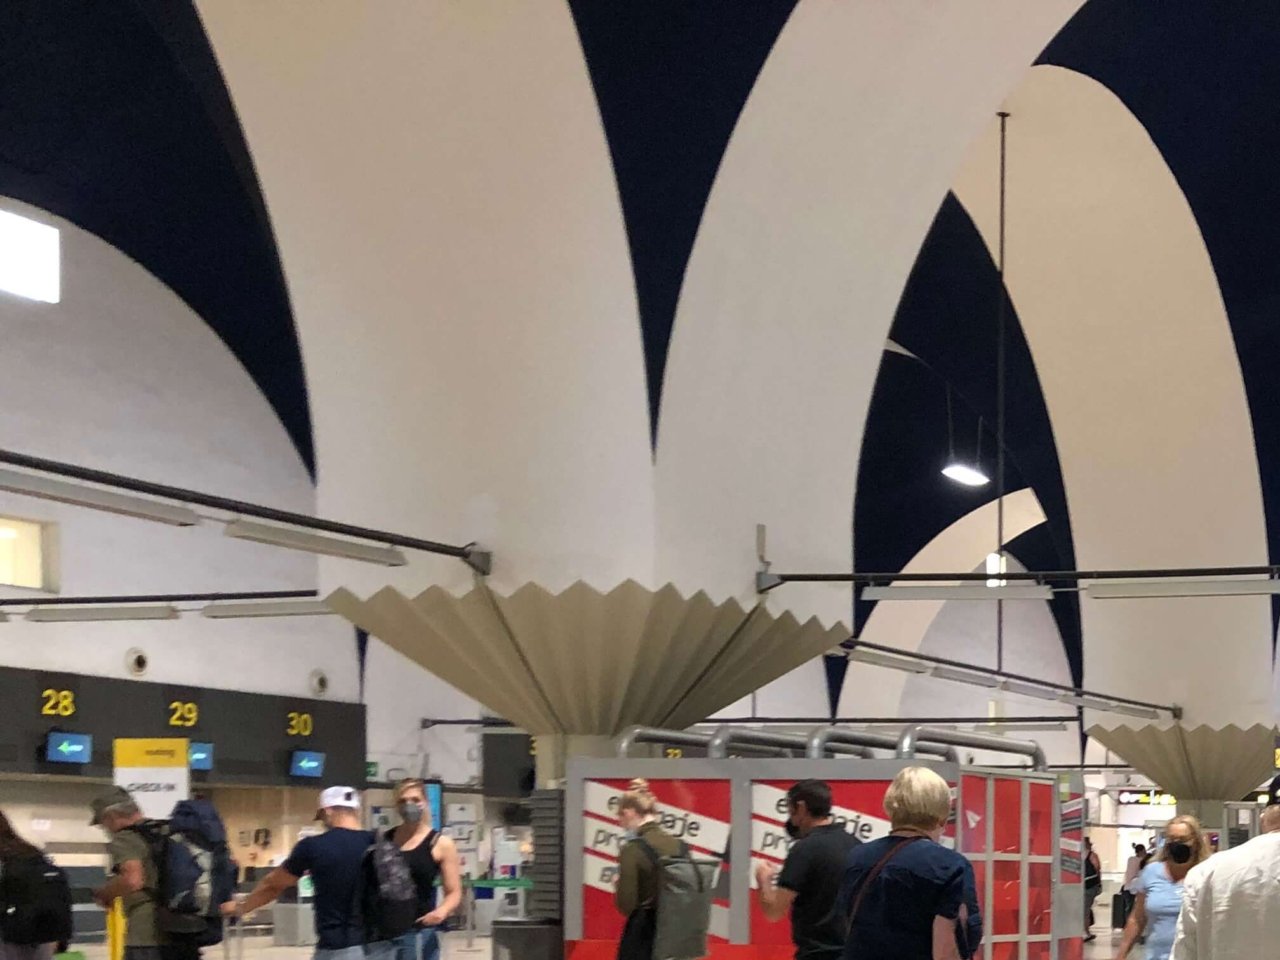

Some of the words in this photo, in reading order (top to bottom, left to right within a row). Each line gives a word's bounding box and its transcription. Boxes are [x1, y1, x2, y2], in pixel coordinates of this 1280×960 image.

[41, 688, 75, 716] 28
[168, 701, 199, 727] 29
[286, 712, 313, 736] 30
